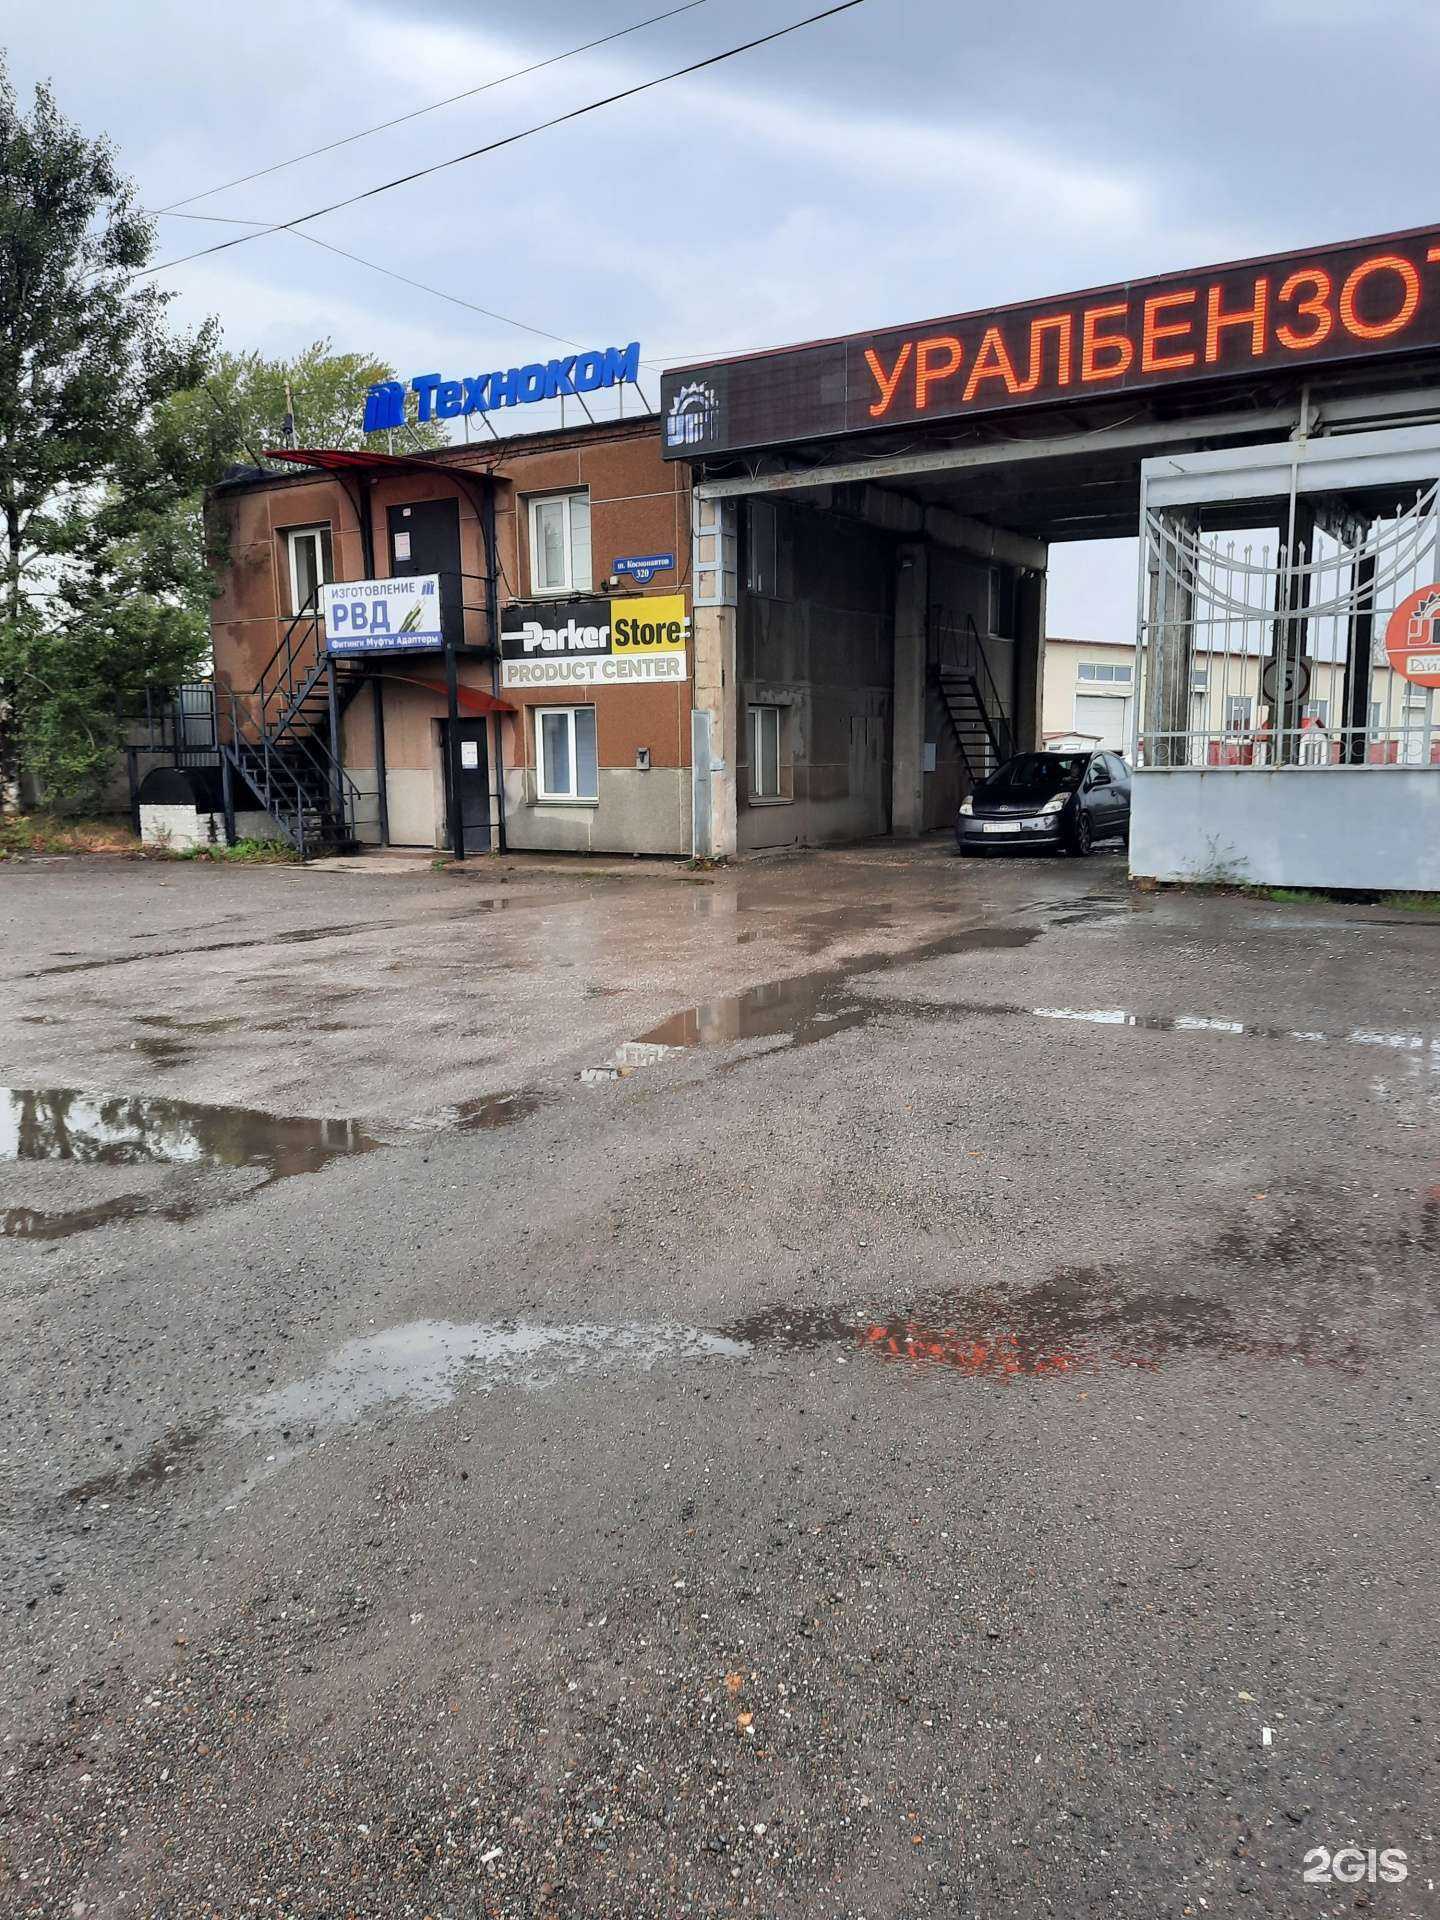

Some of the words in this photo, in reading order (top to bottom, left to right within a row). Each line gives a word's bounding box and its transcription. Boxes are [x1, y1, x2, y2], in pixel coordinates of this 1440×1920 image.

[331, 582, 416, 599] ИЗГОТОВЛЕНИЕ
[332, 600, 391, 633] РВД
[331, 639, 365, 649] Фитинги
[366, 637, 395, 648] Муфты
[396, 634, 439, 646] Адаптеры
[522, 619, 610, 652] Parker
[615, 618, 681, 647] Store
[507, 661, 598, 683] PRODUCT
[601, 657, 681, 679] CENTER
